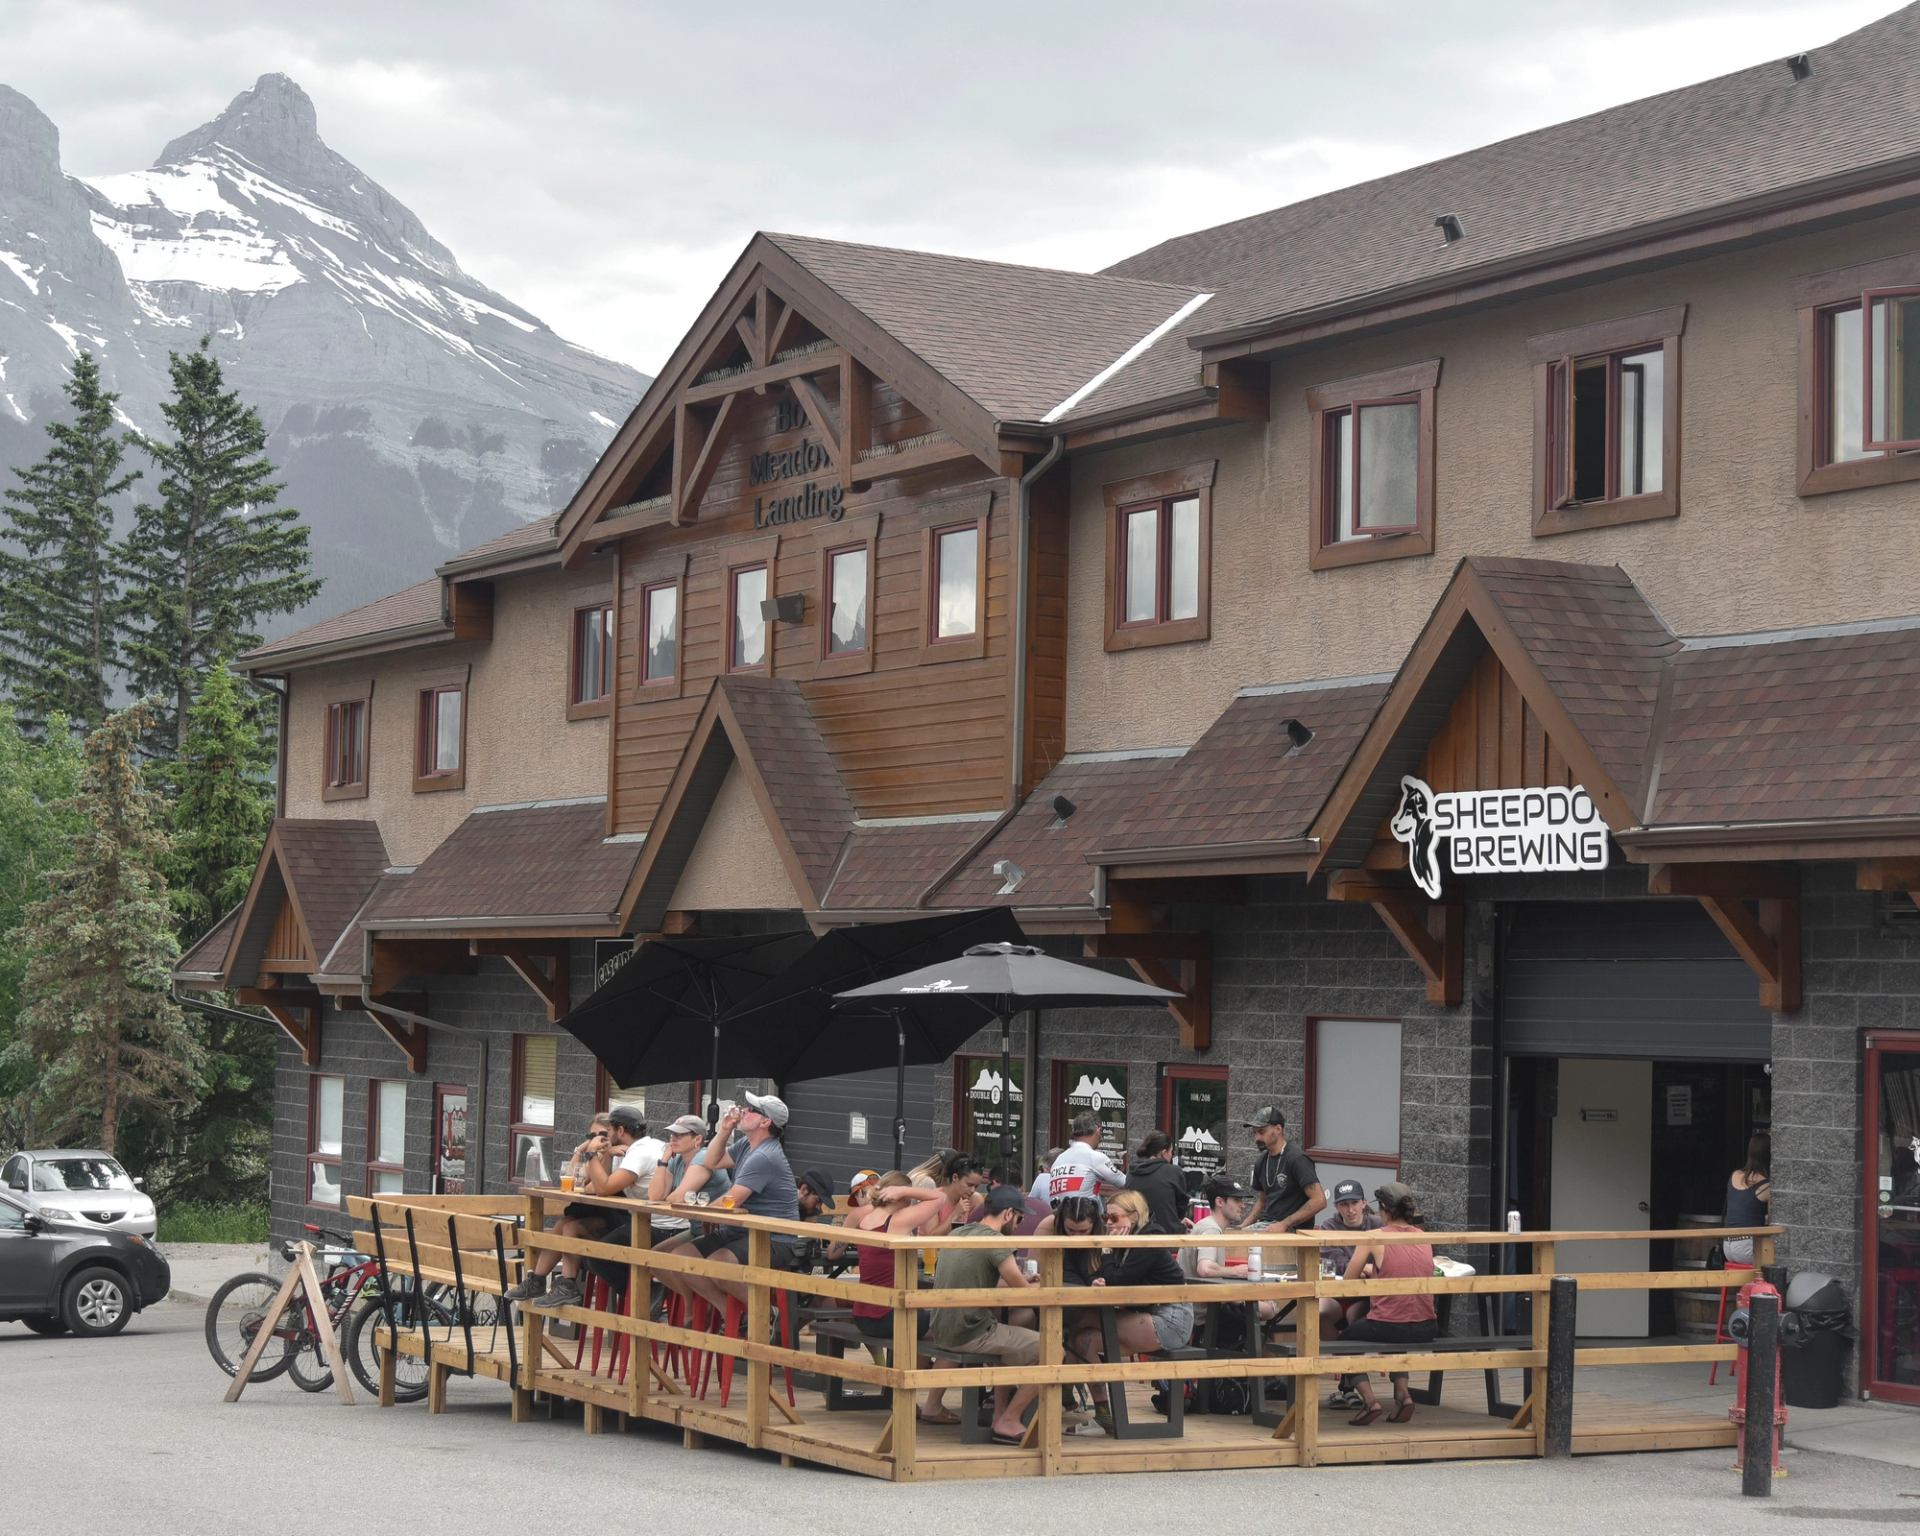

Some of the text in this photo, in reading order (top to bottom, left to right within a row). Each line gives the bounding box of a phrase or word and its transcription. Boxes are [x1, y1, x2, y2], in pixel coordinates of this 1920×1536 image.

[755, 482, 845, 530] Landing
[1435, 791, 1602, 831] SHEEPDO
[1453, 831, 1601, 868] BREWING
[970, 1090, 990, 1100] DOUBLE
[1069, 1096, 1091, 1106] DOUBLE
[1102, 1099, 1126, 1109] MOTORS
